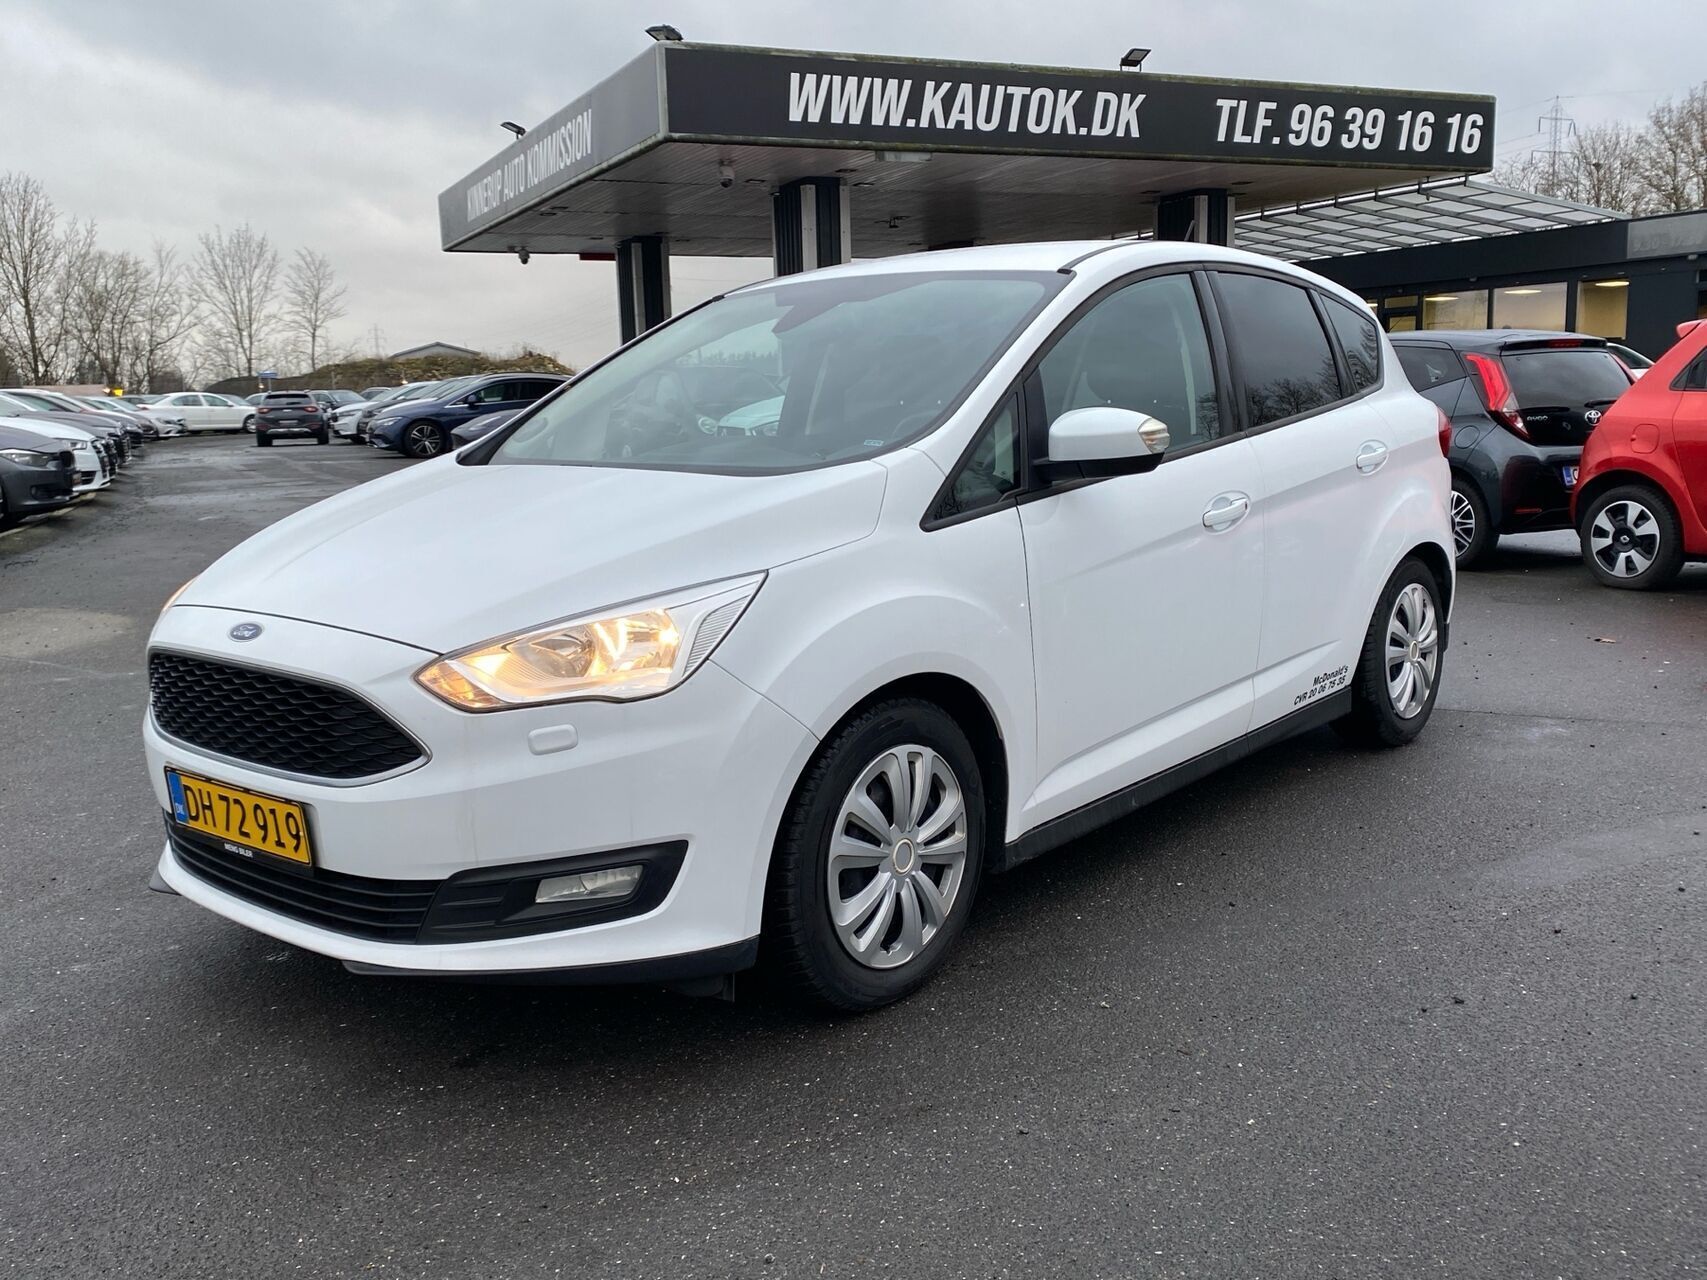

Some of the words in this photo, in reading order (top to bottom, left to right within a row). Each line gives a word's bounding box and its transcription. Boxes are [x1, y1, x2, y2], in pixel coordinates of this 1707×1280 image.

[788, 72, 1147, 138] WWW.KAUTOK.DK
[1215, 98, 1282, 145] TLF.
[1287, 103, 1335, 148] 96
[1340, 106, 1386, 150] 39
[1397, 110, 1435, 152] 16
[1447, 113, 1484, 154] 16
[503, 153, 525, 202] AUTO
[527, 108, 592, 189] KOMMISSION
[1294, 691, 1308, 706] CVR
[1313, 665, 1349, 687] McDonald's
